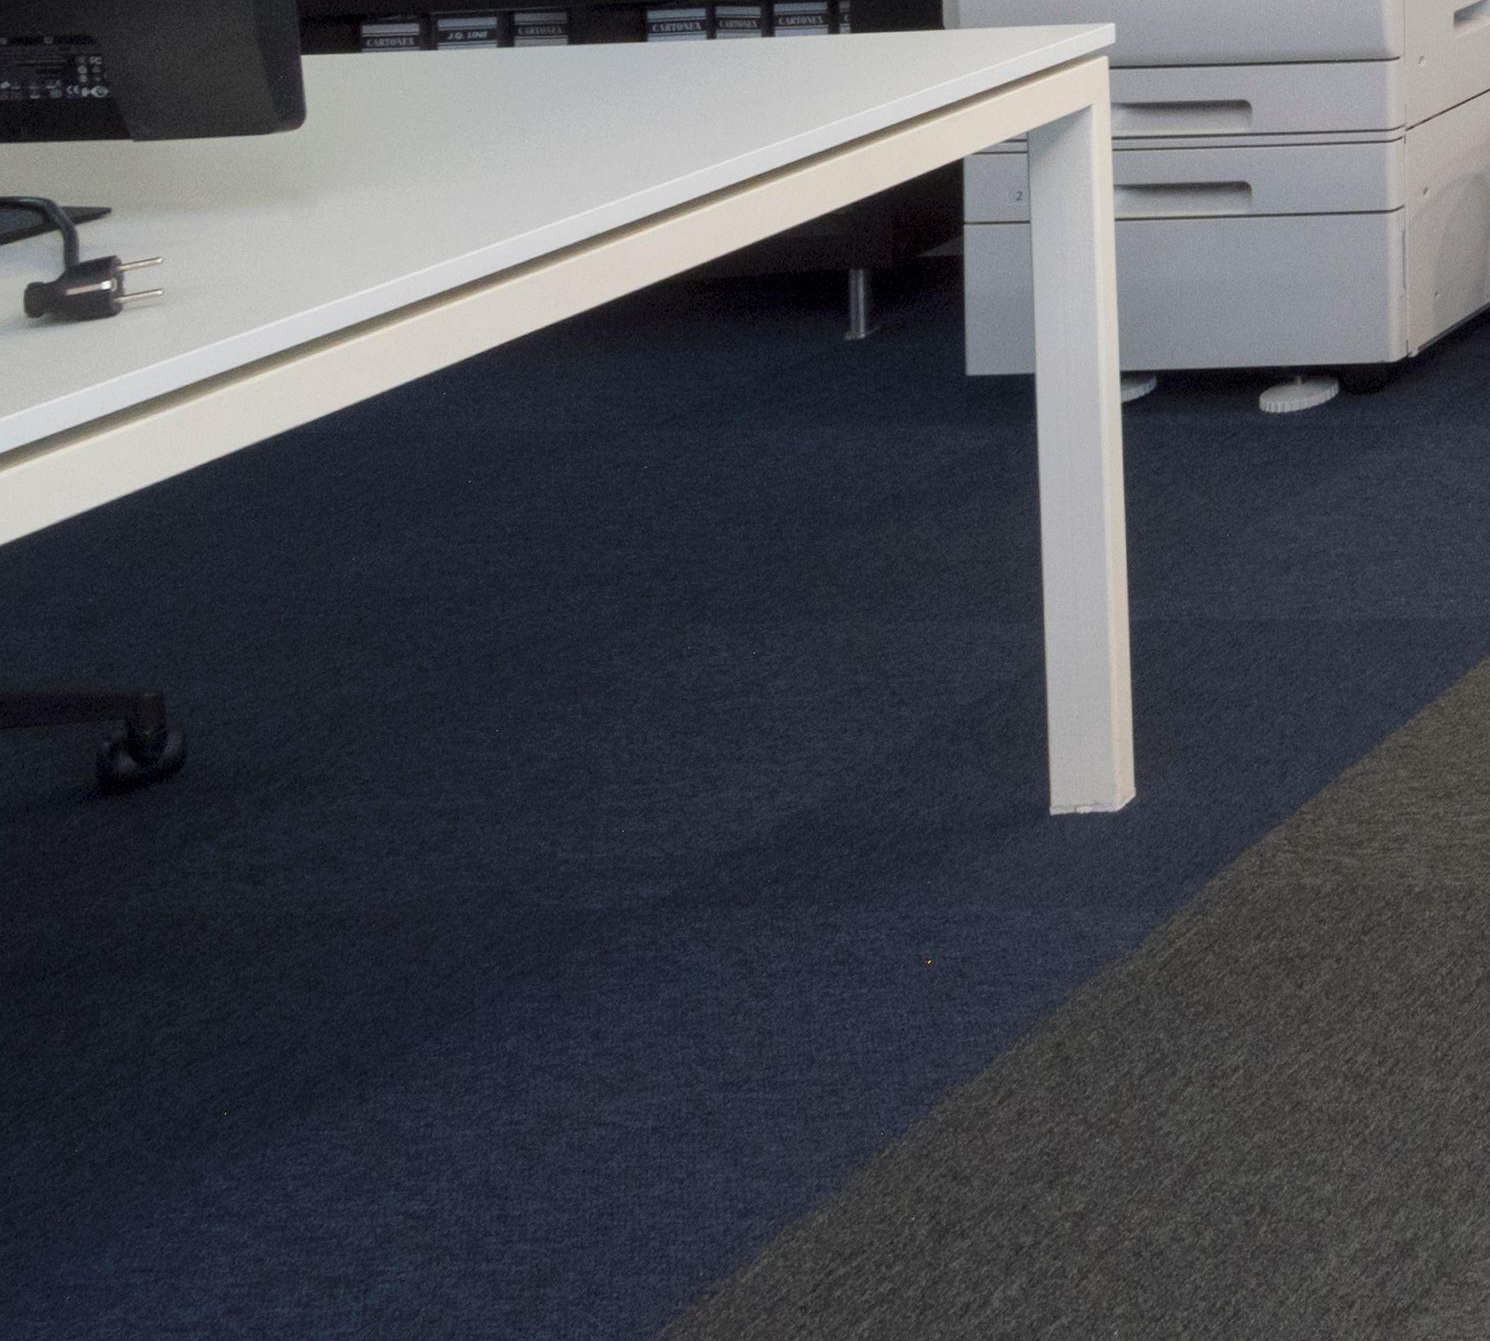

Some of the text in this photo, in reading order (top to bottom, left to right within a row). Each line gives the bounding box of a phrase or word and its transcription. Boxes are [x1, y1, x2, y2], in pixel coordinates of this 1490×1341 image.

[718, 19, 758, 29] CARTONEX
[778, 15, 824, 26] CARTONEX
[651, 21, 702, 33] CARTONEX
[467, 30, 489, 40] LINE
[1015, 190, 1024, 202] 2
